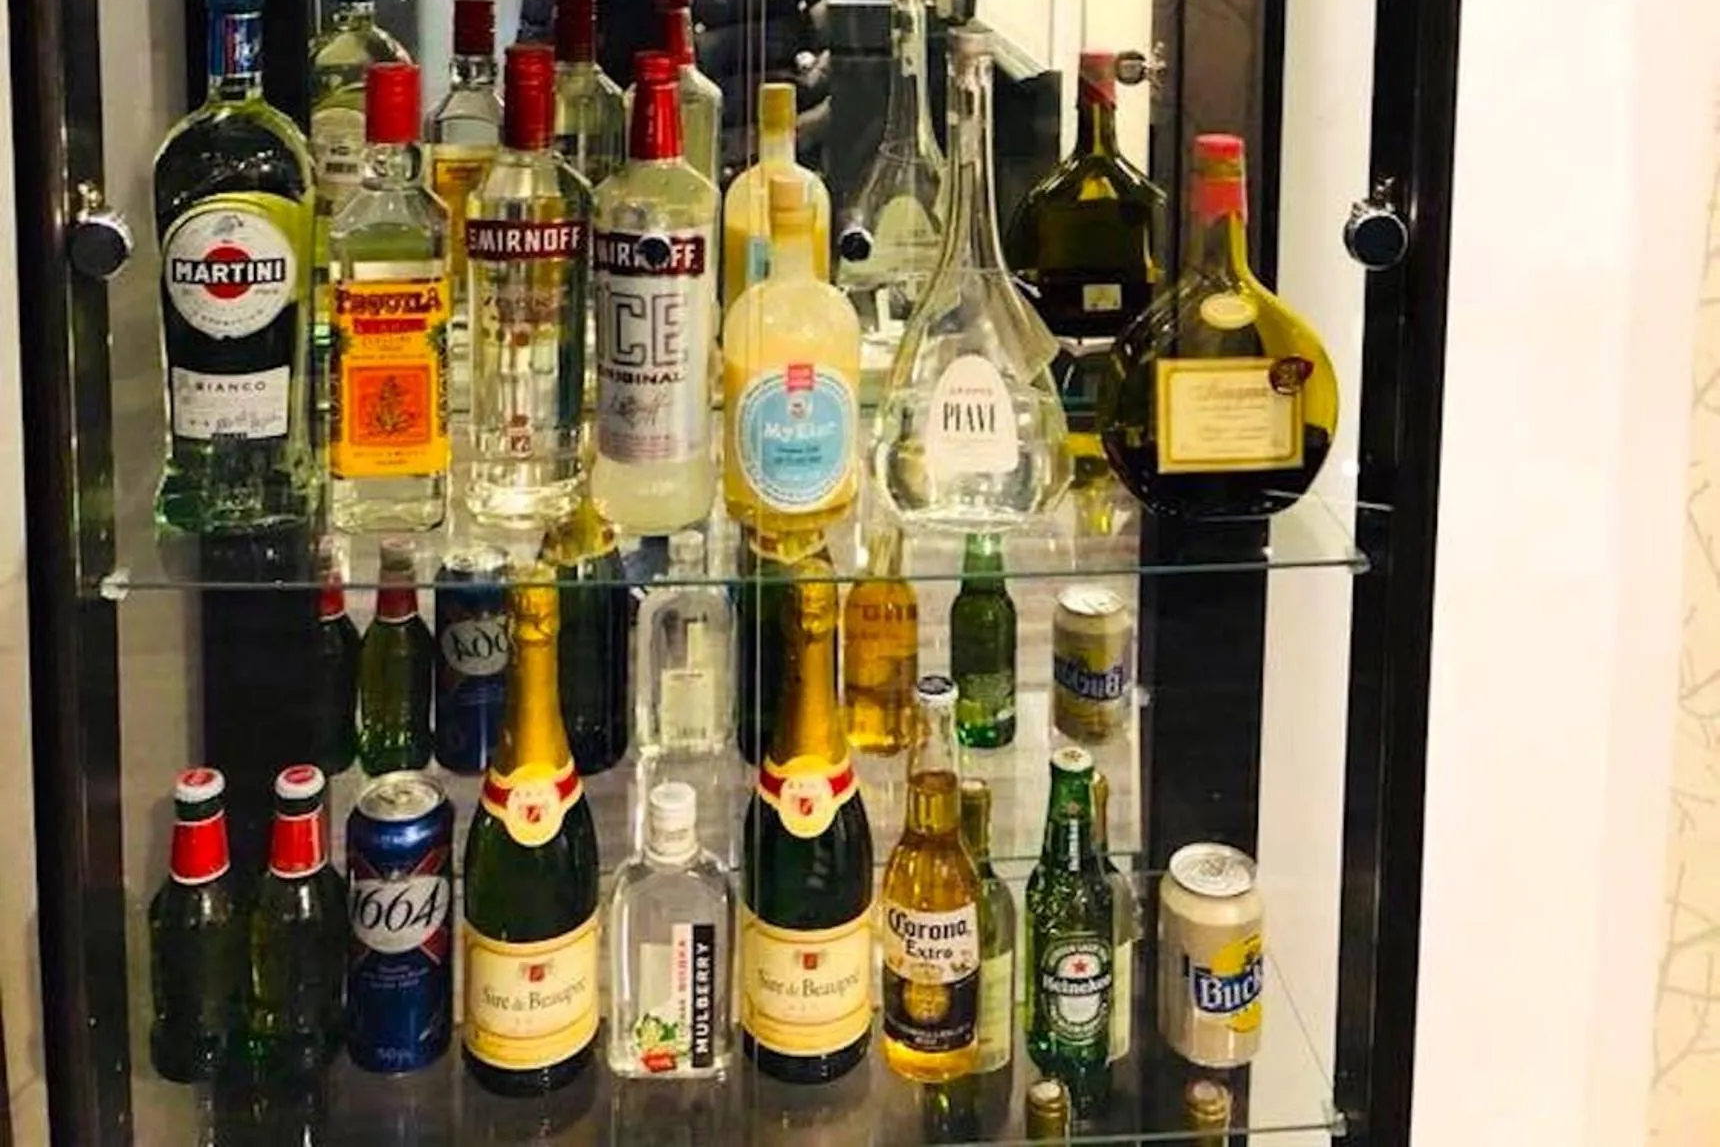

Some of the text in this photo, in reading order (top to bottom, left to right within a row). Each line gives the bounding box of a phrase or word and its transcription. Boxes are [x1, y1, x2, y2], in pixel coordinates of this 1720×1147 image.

[468, 224, 581, 254] SMIRNOFF
[174, 260, 284, 282] MARTINI
[887, 907, 968, 941] Corona
[905, 938, 953, 960] Extra
[1042, 973, 1112, 994] Heineken
[695, 941, 711, 1054] MULBERRY
